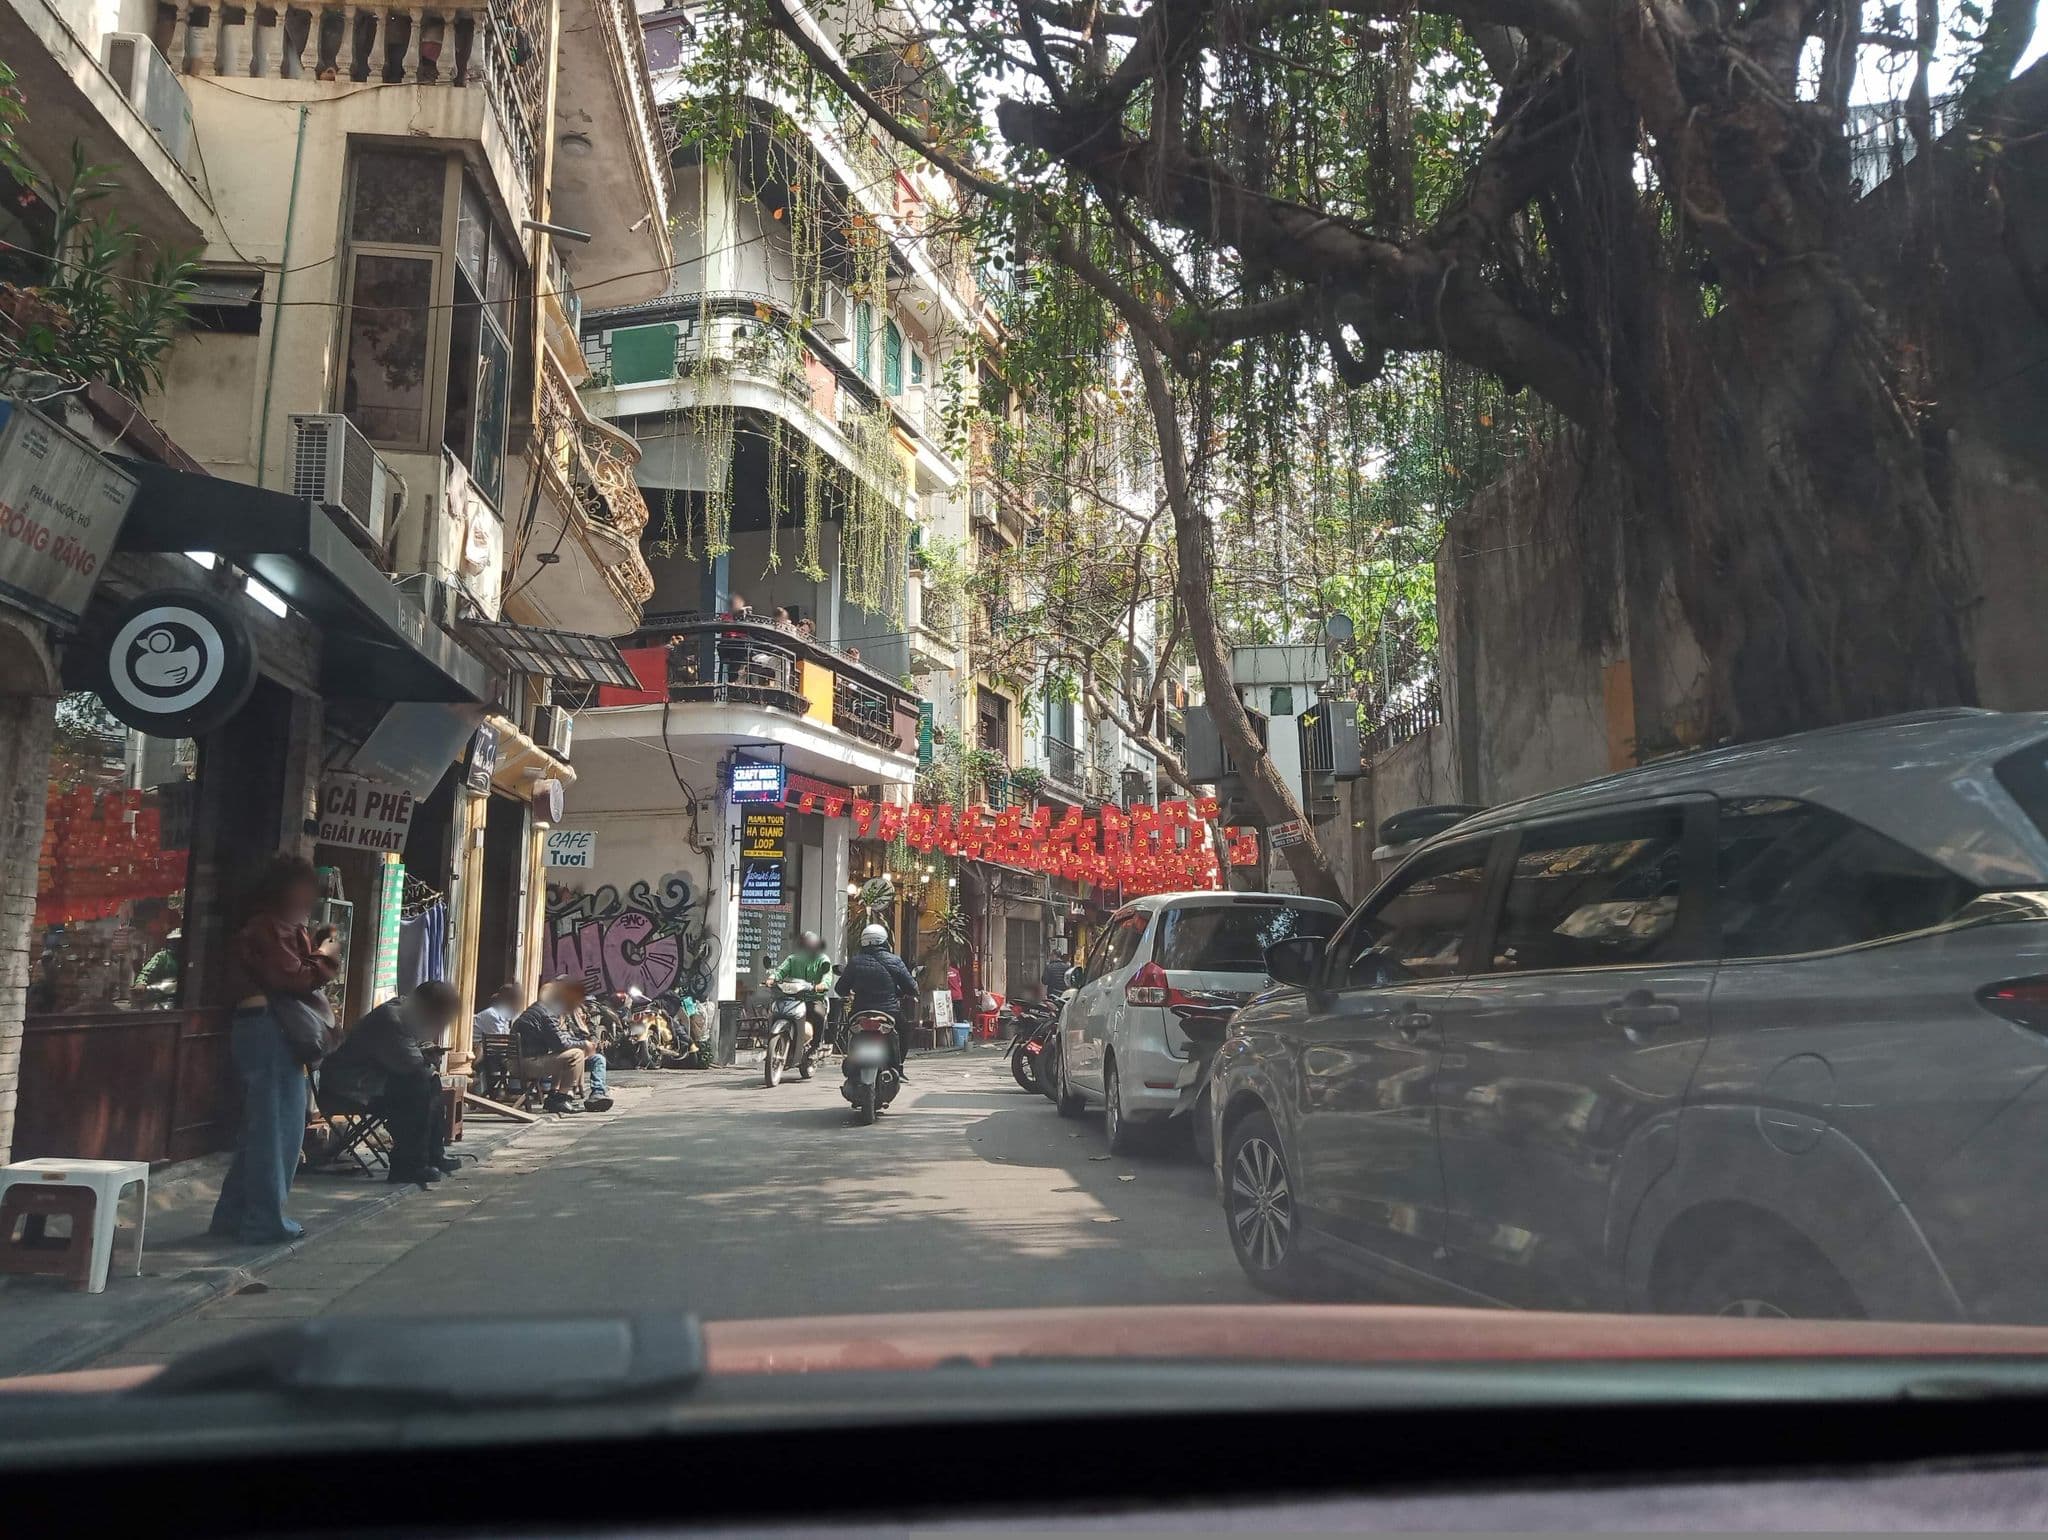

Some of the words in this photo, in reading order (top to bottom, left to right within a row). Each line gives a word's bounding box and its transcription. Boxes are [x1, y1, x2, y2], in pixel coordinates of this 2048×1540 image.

[50, 535, 97, 576] RĂNG
[364, 790, 412, 825] PHÊ
[747, 815, 766, 824] MAMA
[767, 816, 784, 825] TOUR
[321, 820, 355, 844] GIẢI
[358, 828, 403, 850] KHÁT
[746, 826, 758, 837] HA
[759, 826, 783, 838] GIANG
[754, 839, 775, 849] LOOP
[551, 851, 586, 866] Tươi
[763, 889, 781, 897] OFFICE
